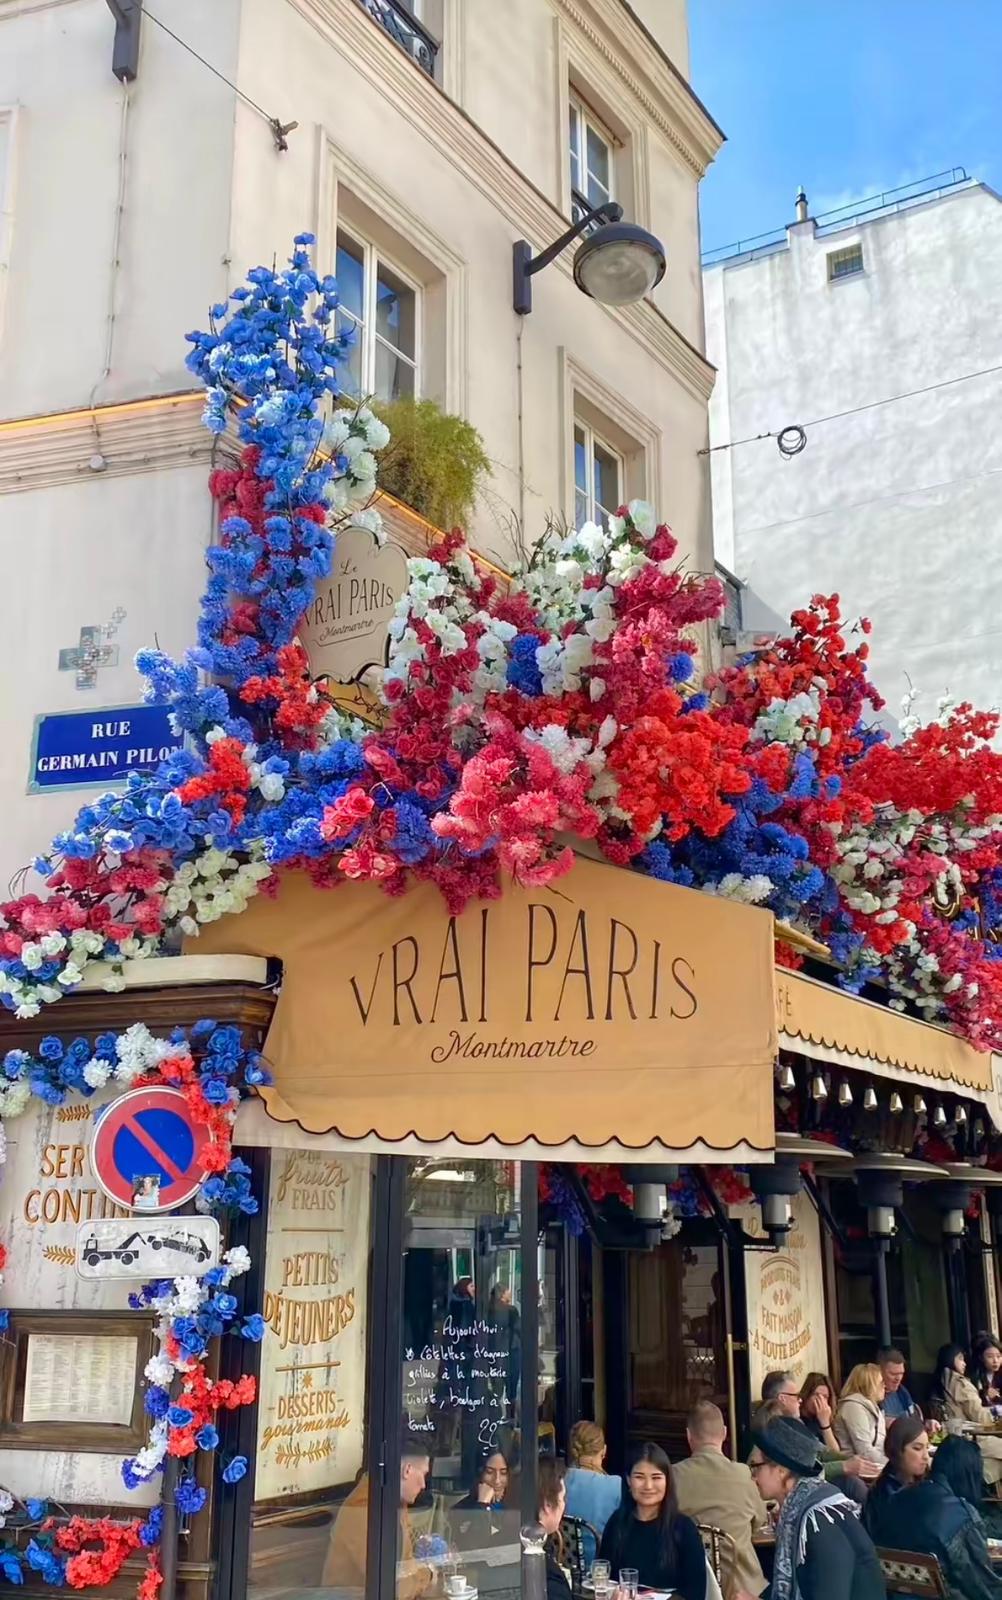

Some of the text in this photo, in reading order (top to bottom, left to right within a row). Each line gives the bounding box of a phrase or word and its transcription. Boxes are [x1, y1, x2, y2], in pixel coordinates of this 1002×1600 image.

[340, 559, 358, 576] Le
[304, 578, 394, 626] VRAI PARIS
[320, 619, 374, 641] Montmartre
[91, 720, 131, 738] RUE
[38, 751, 119, 773] GERMAIN
[350, 903, 699, 1027] VRAI PARIS
[431, 1030, 598, 1064] Montmartre
[41, 1144, 90, 1178] SER
[24, 1188, 131, 1224] CONTIN
[291, 1188, 337, 1211] FRAIS
[282, 1252, 340, 1287] PETITS
[263, 1288, 355, 1350] DÉJEUNERS
[277, 1390, 337, 1420] DESSERTS
[261, 1408, 351, 1450] gourmands
